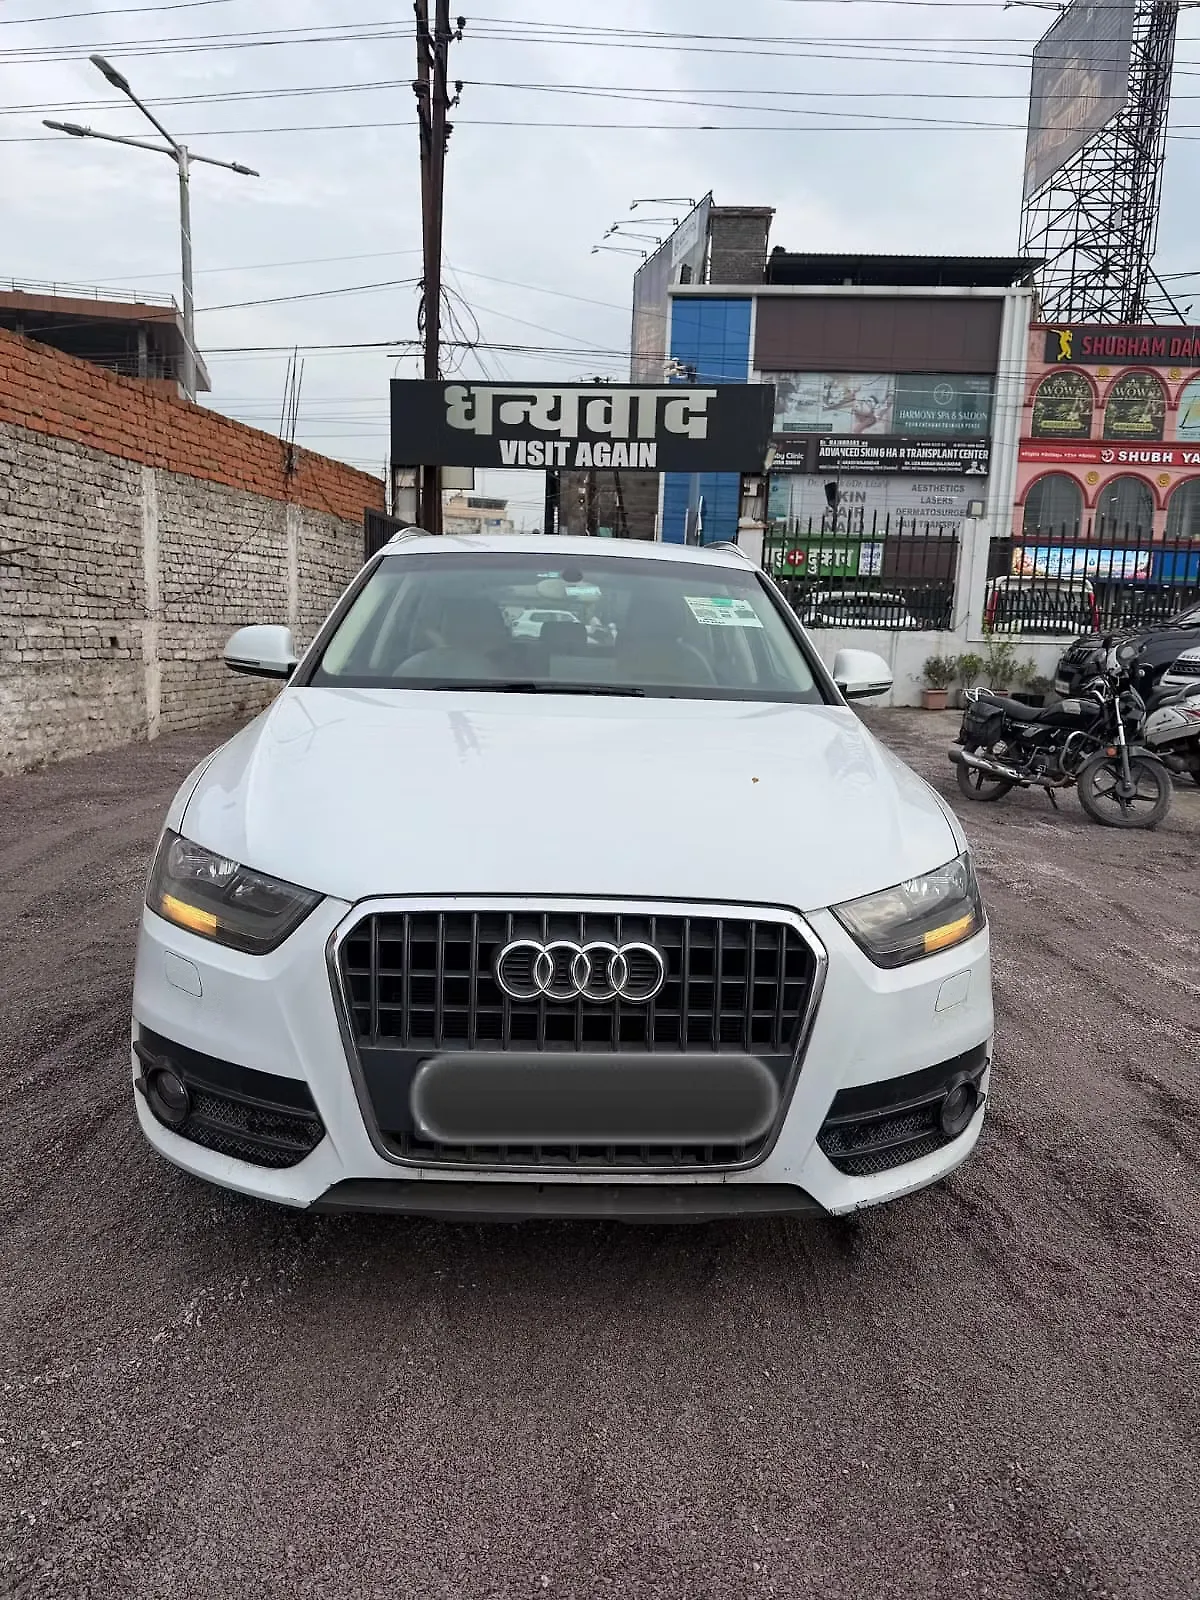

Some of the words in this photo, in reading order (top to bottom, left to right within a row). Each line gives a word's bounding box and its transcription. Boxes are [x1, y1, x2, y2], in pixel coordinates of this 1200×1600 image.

[1081, 335, 1165, 357] SHUBHAM
[444, 385, 717, 439] धन्यवाद
[899, 409, 935, 419] HARMONY
[937, 411, 950, 420] SPA
[499, 439, 571, 467] VISIT
[574, 441, 658, 468] AGAIN
[818, 447, 860, 457] ADVANCED
[859, 448, 879, 458] SKIN
[885, 448, 906, 458] HAR
[906, 448, 958, 459] TRANSPLANT
[959, 449, 989, 460] CENTER
[1117, 451, 1173, 463] SHUBH
[911, 484, 966, 493] AESTHETICS
[836, 491, 867, 503] KIN
[919, 496, 954, 505] LASERS
